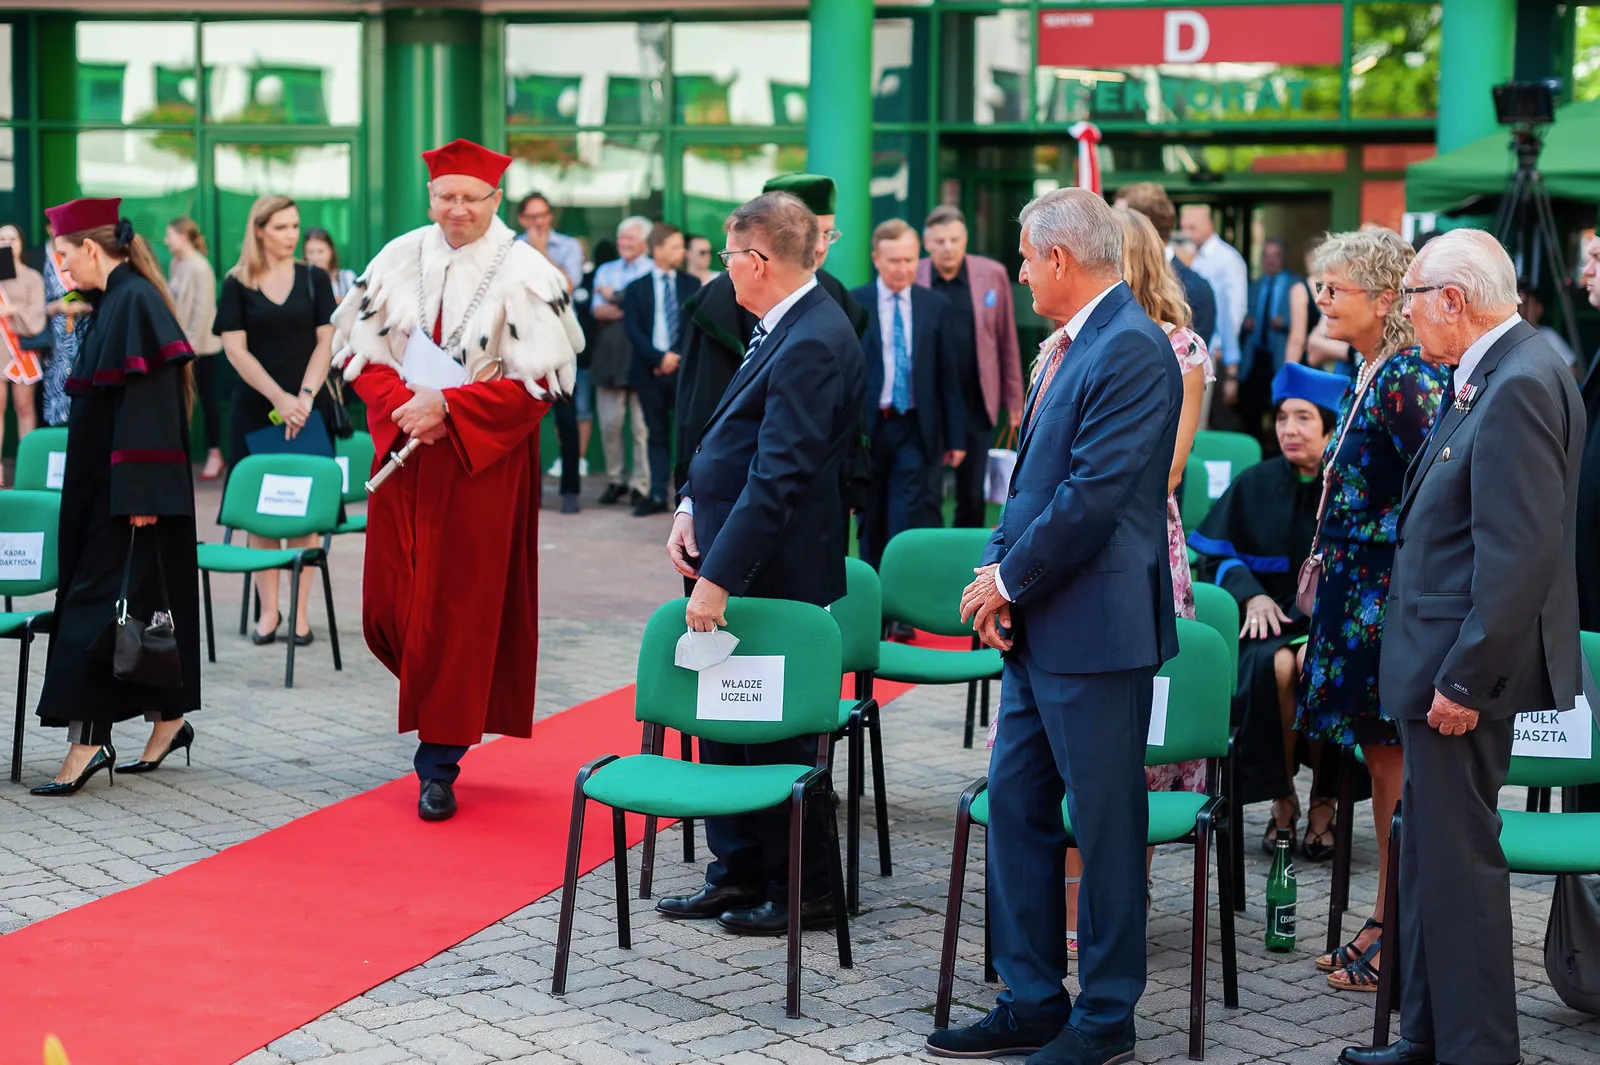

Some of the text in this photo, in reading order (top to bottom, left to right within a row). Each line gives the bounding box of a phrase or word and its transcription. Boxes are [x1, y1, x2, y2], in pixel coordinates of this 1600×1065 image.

[1163, 10, 1210, 63] D
[721, 679, 763, 688] WŁADZE
[720, 692, 762, 702] UCZELNI
[1520, 712, 1560, 725] PUŁK
